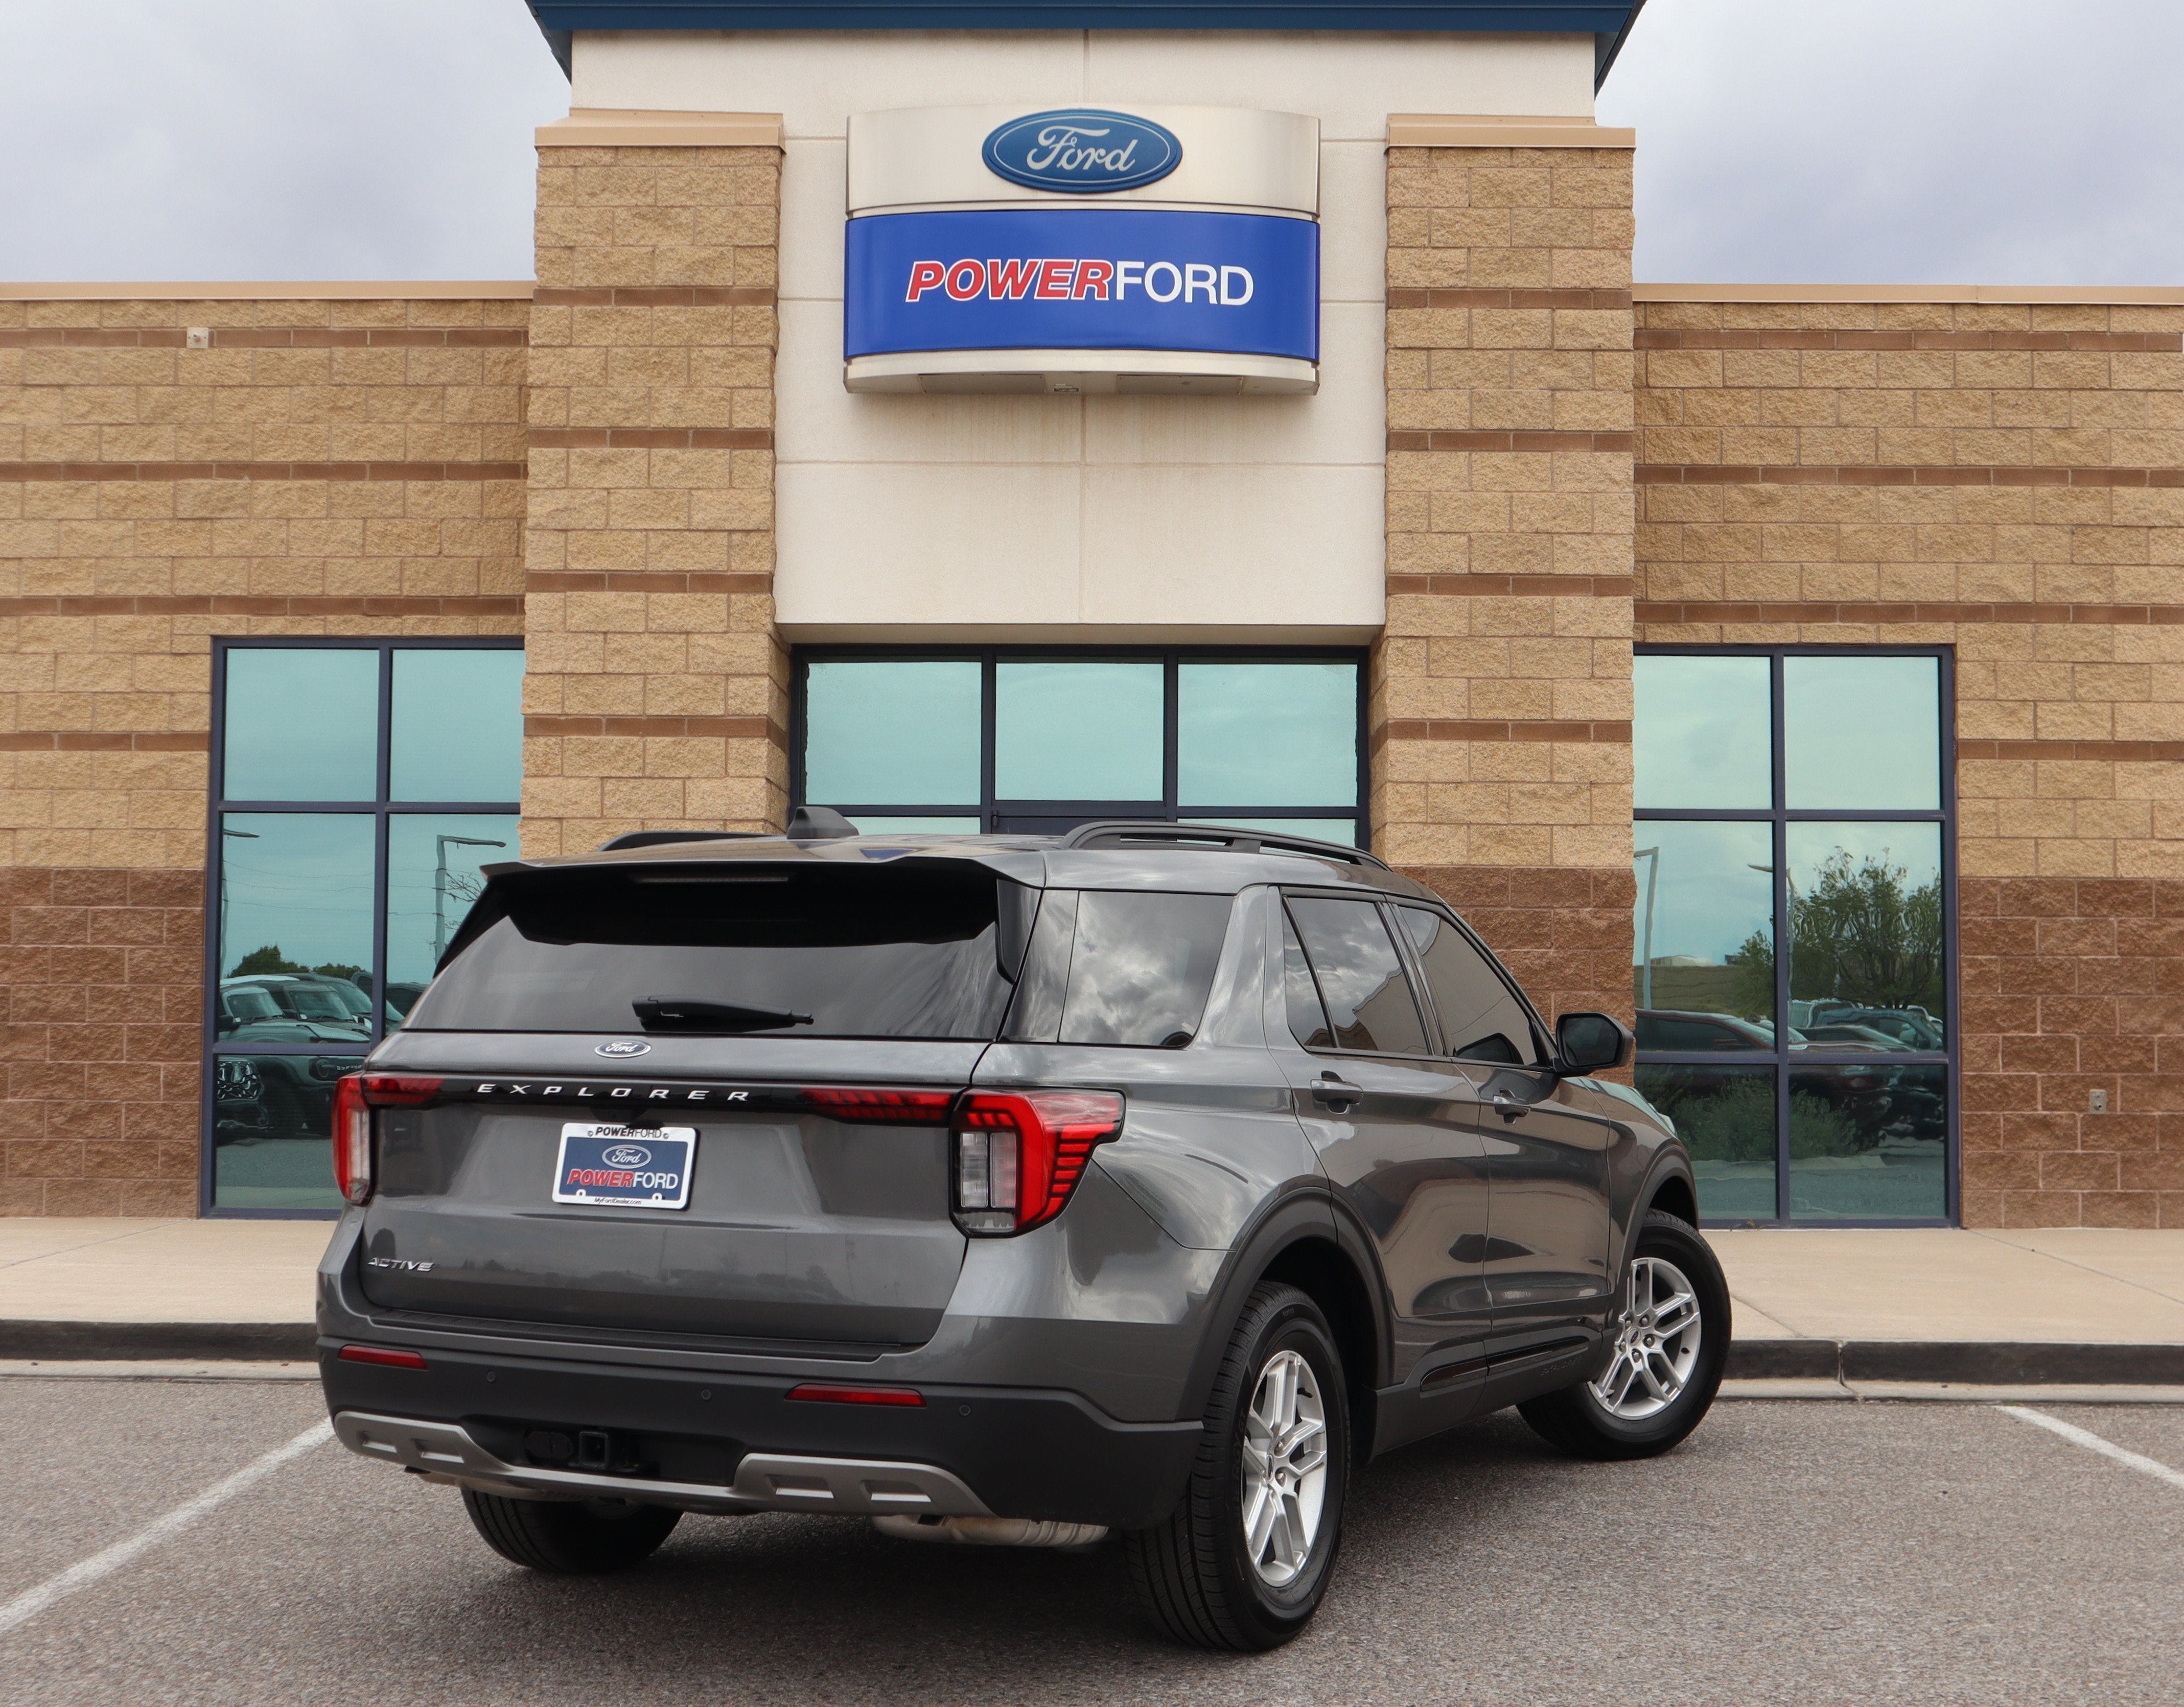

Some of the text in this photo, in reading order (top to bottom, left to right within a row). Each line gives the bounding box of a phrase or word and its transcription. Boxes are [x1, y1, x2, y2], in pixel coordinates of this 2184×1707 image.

[1026, 125, 1139, 173] Ford
[905, 258, 1254, 306] POWERFORD
[605, 1042, 638, 1053] Ford
[477, 1084, 750, 1101] EXPLORER
[596, 1127, 662, 1138] POWERFORD
[611, 1149, 642, 1164] Ford
[566, 1168, 679, 1189] POWERFORD
[368, 1257, 434, 1271] ACTIVE
